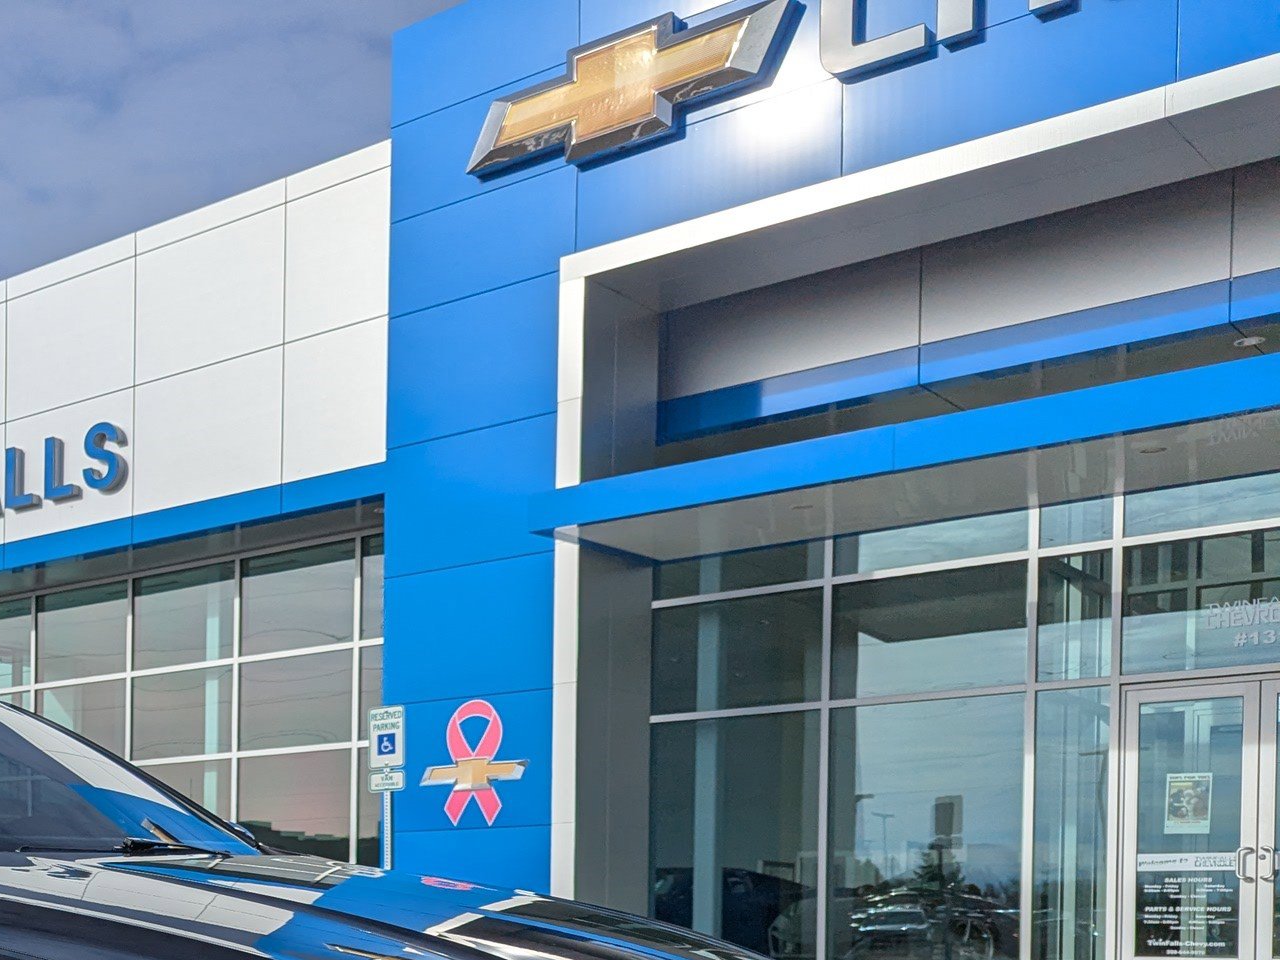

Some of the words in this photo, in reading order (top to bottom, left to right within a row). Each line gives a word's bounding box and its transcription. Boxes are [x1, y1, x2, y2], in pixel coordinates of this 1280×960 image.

[1234, 630, 1280, 647] #13
[370, 711, 402, 721] RESERVED
[373, 722, 400, 732] PARKING
